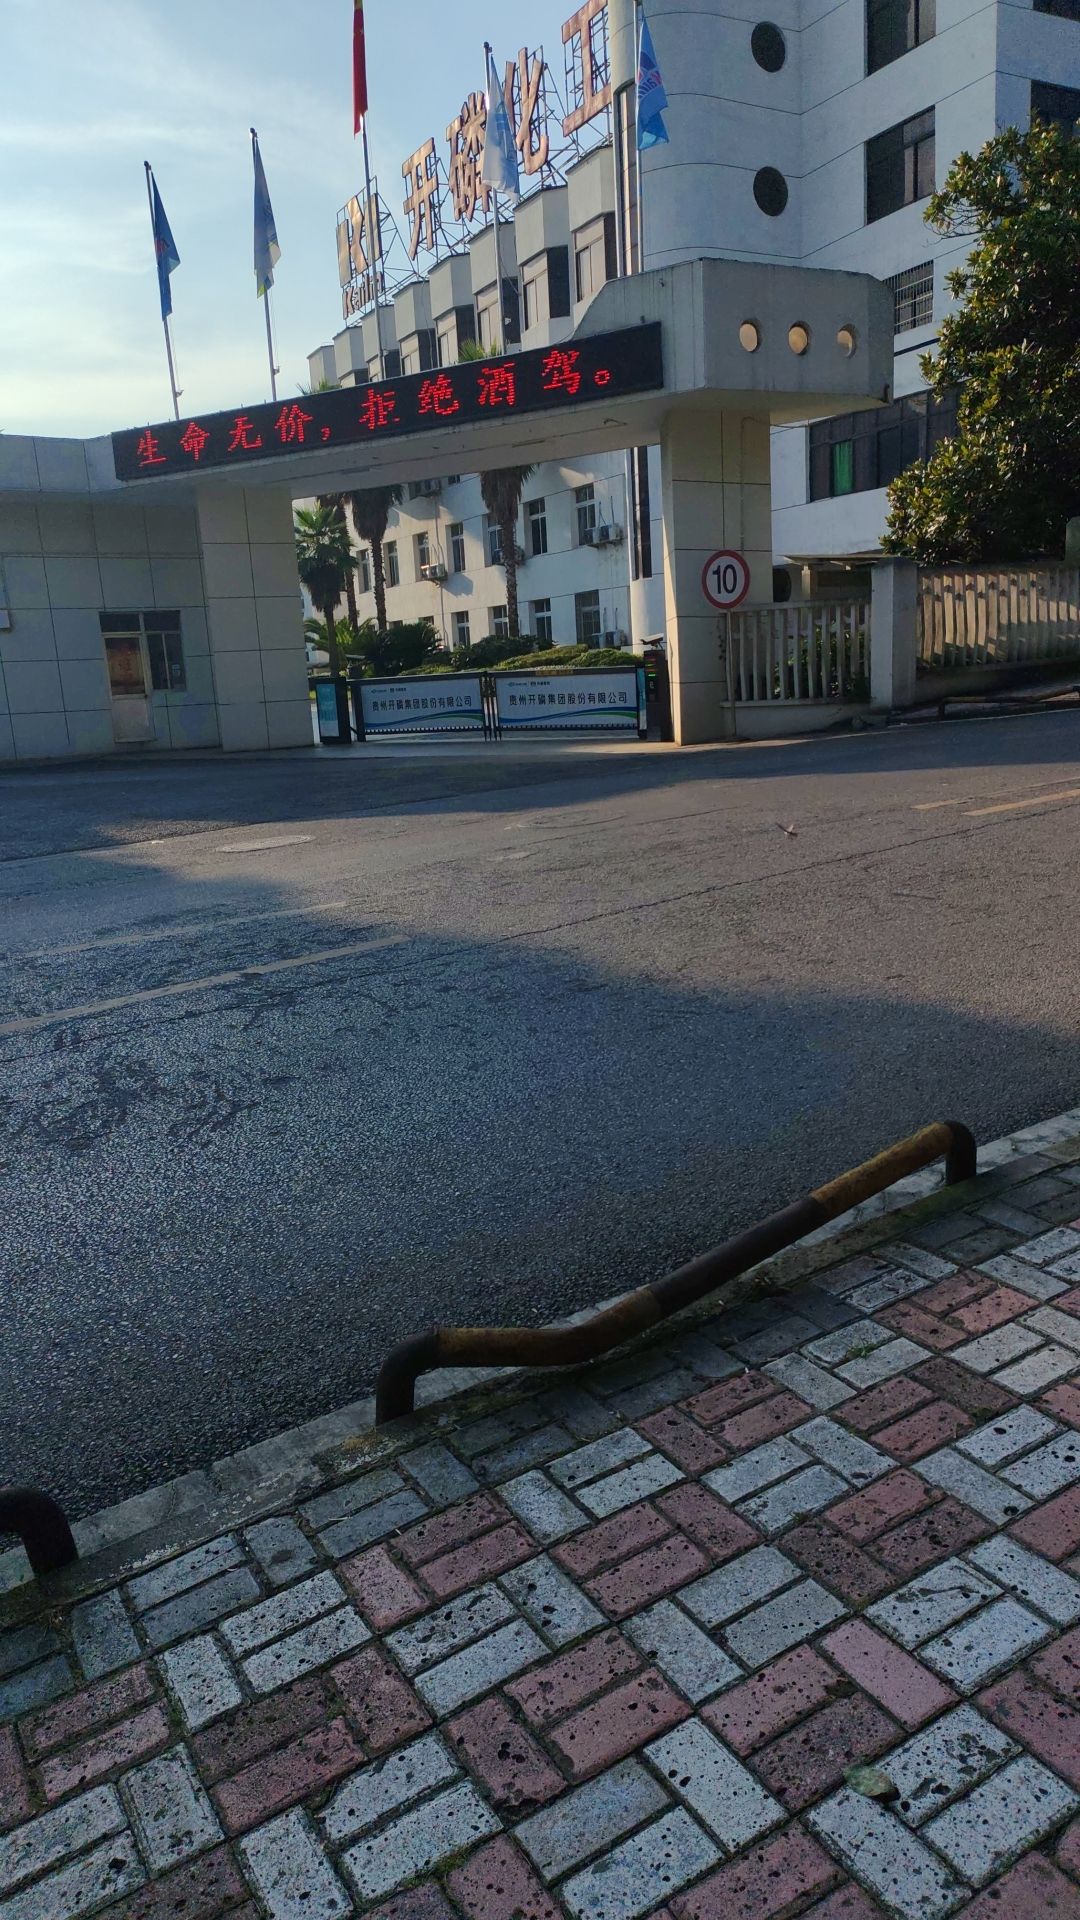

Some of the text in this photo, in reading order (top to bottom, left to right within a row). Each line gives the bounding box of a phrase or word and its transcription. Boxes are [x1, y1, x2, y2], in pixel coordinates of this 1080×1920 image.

[712, 563, 738, 595] 10
[509, 691, 627, 706] 贵州开磷集团股份有限公司
